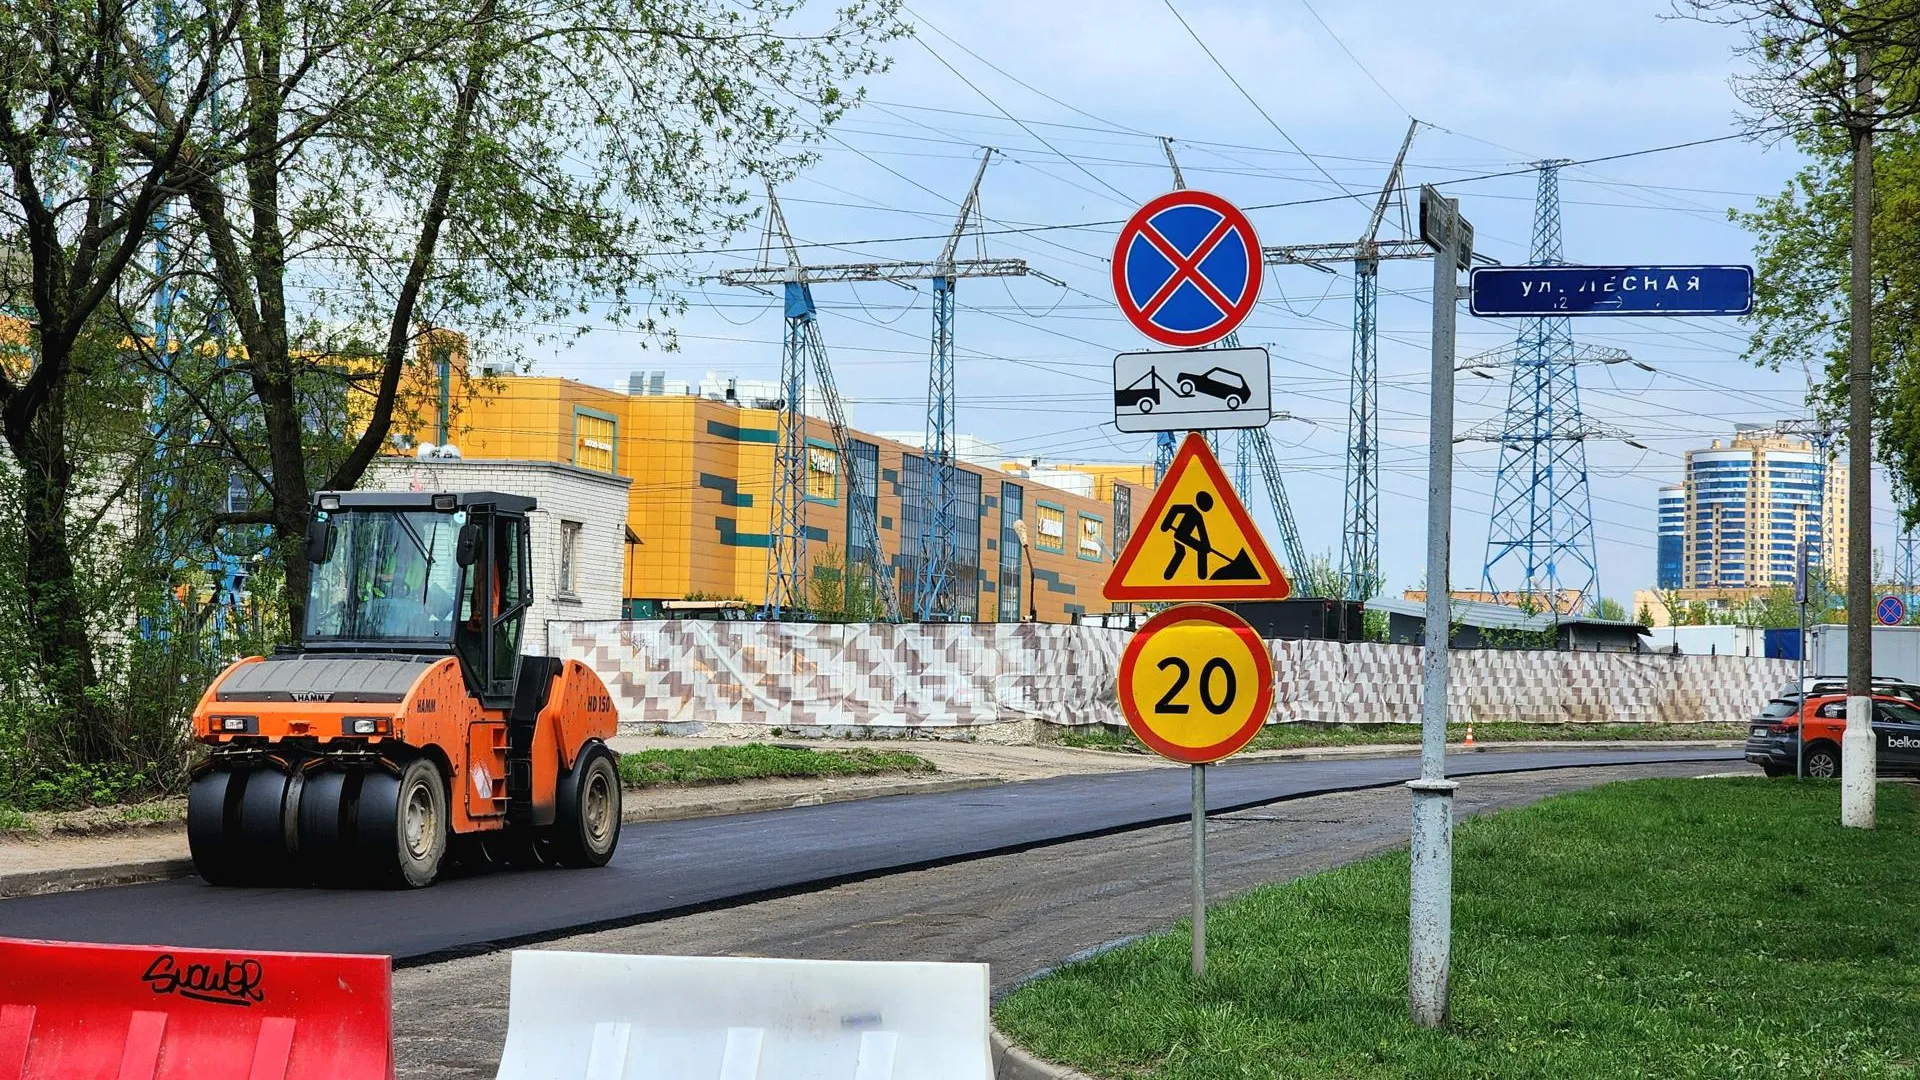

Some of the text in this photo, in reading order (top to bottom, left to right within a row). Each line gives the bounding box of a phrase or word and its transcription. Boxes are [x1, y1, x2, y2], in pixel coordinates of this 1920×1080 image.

[1521, 280, 1564, 297] ул.
[1155, 657, 1236, 714] 20
[297, 694, 325, 702] HAMM
[587, 696, 611, 712] HD 150
[417, 699, 435, 713] HAMM
[1888, 735, 1920, 748] belka
